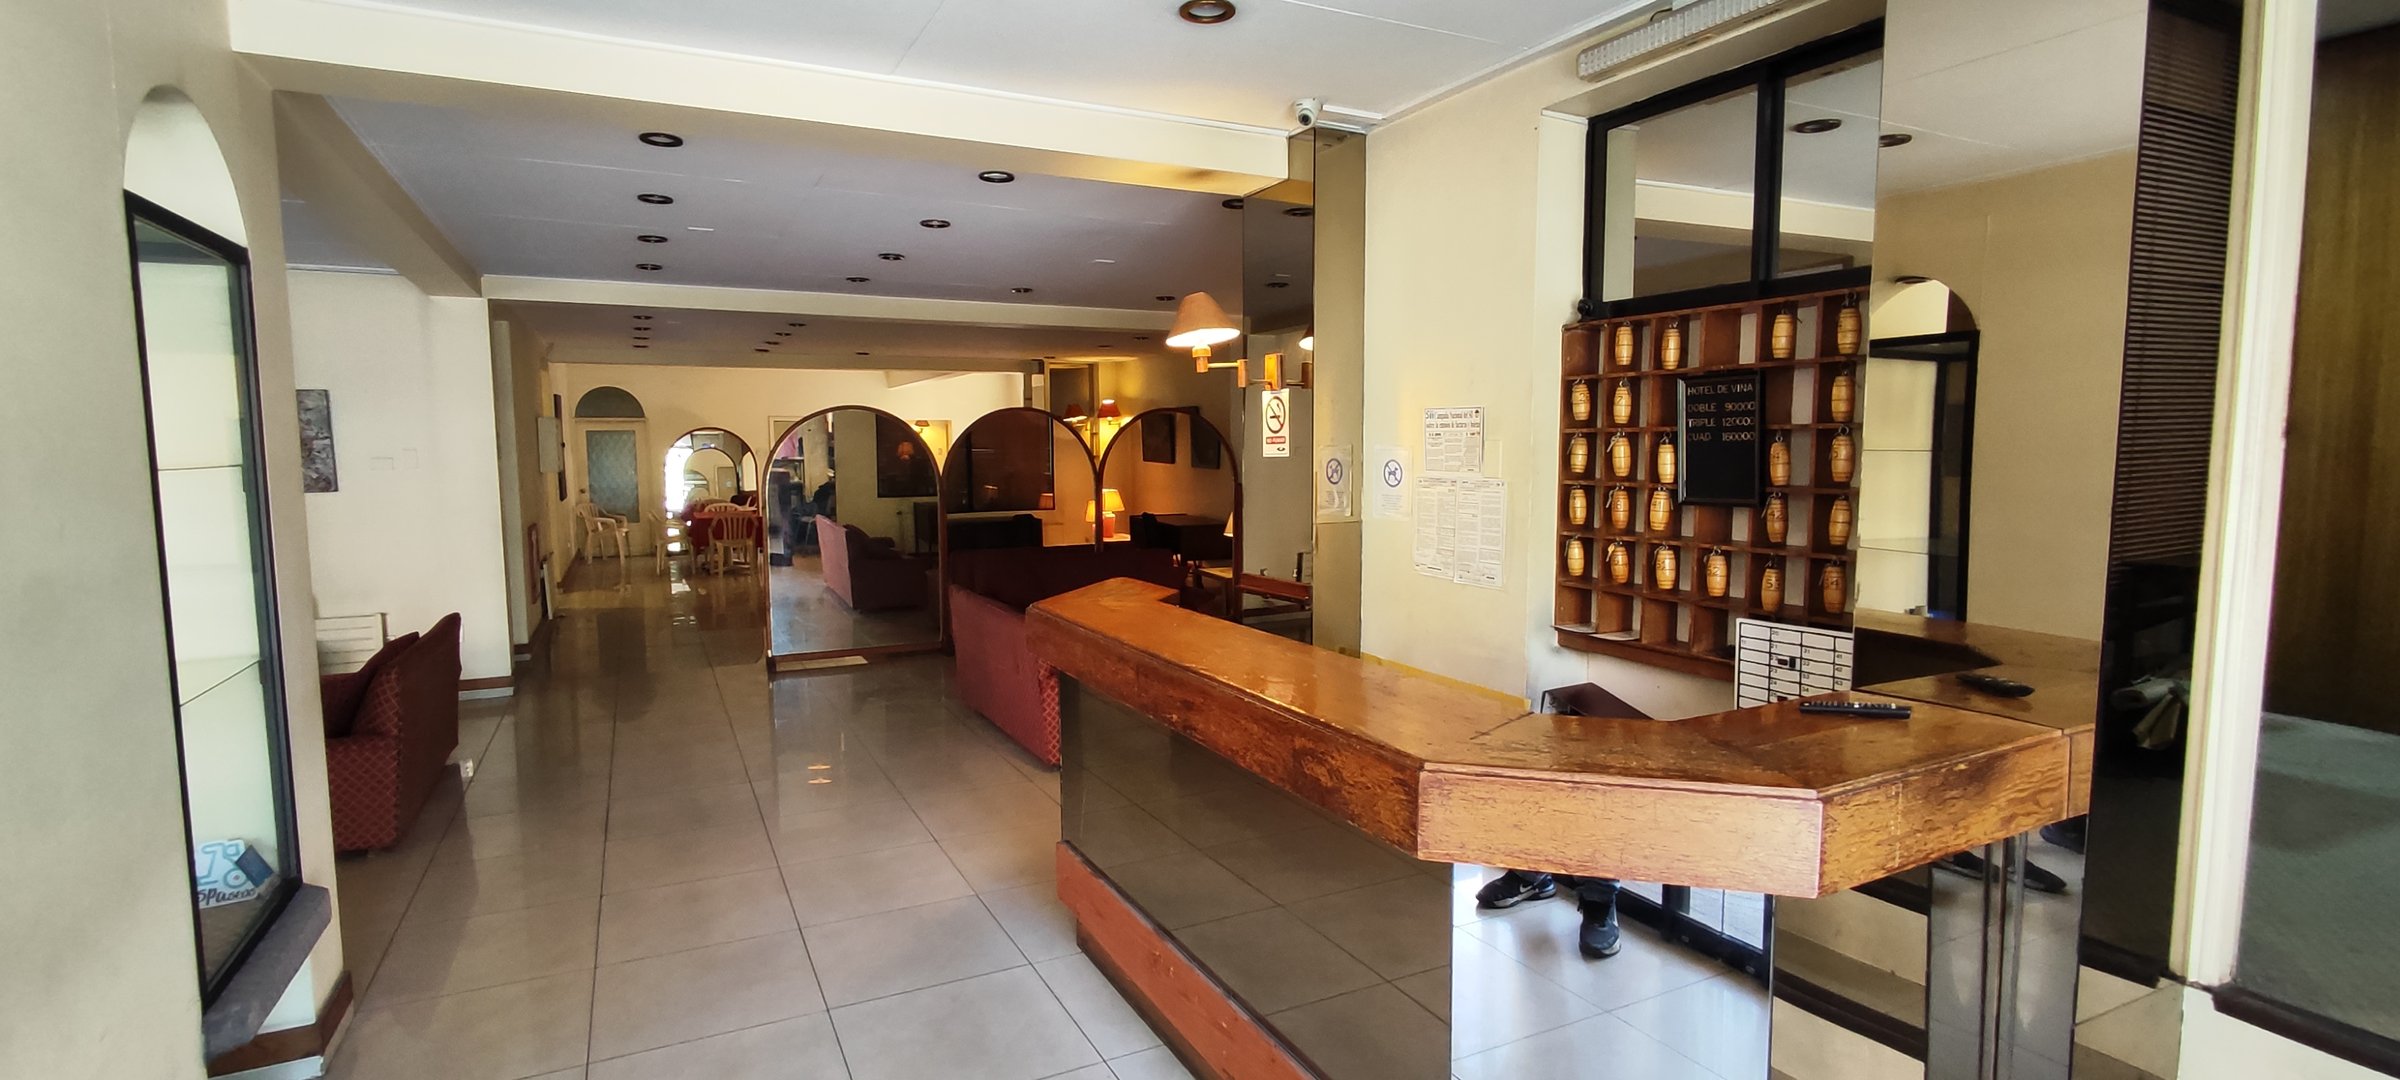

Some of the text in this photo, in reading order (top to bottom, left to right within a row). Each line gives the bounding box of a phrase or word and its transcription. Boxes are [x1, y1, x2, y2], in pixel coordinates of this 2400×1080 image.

[1687, 386, 1715, 396] HOTEL
[1717, 384, 1729, 394] DE
[1688, 402, 1756, 413] DOBLE 90000
[1687, 418, 1716, 428] TRIPLE
